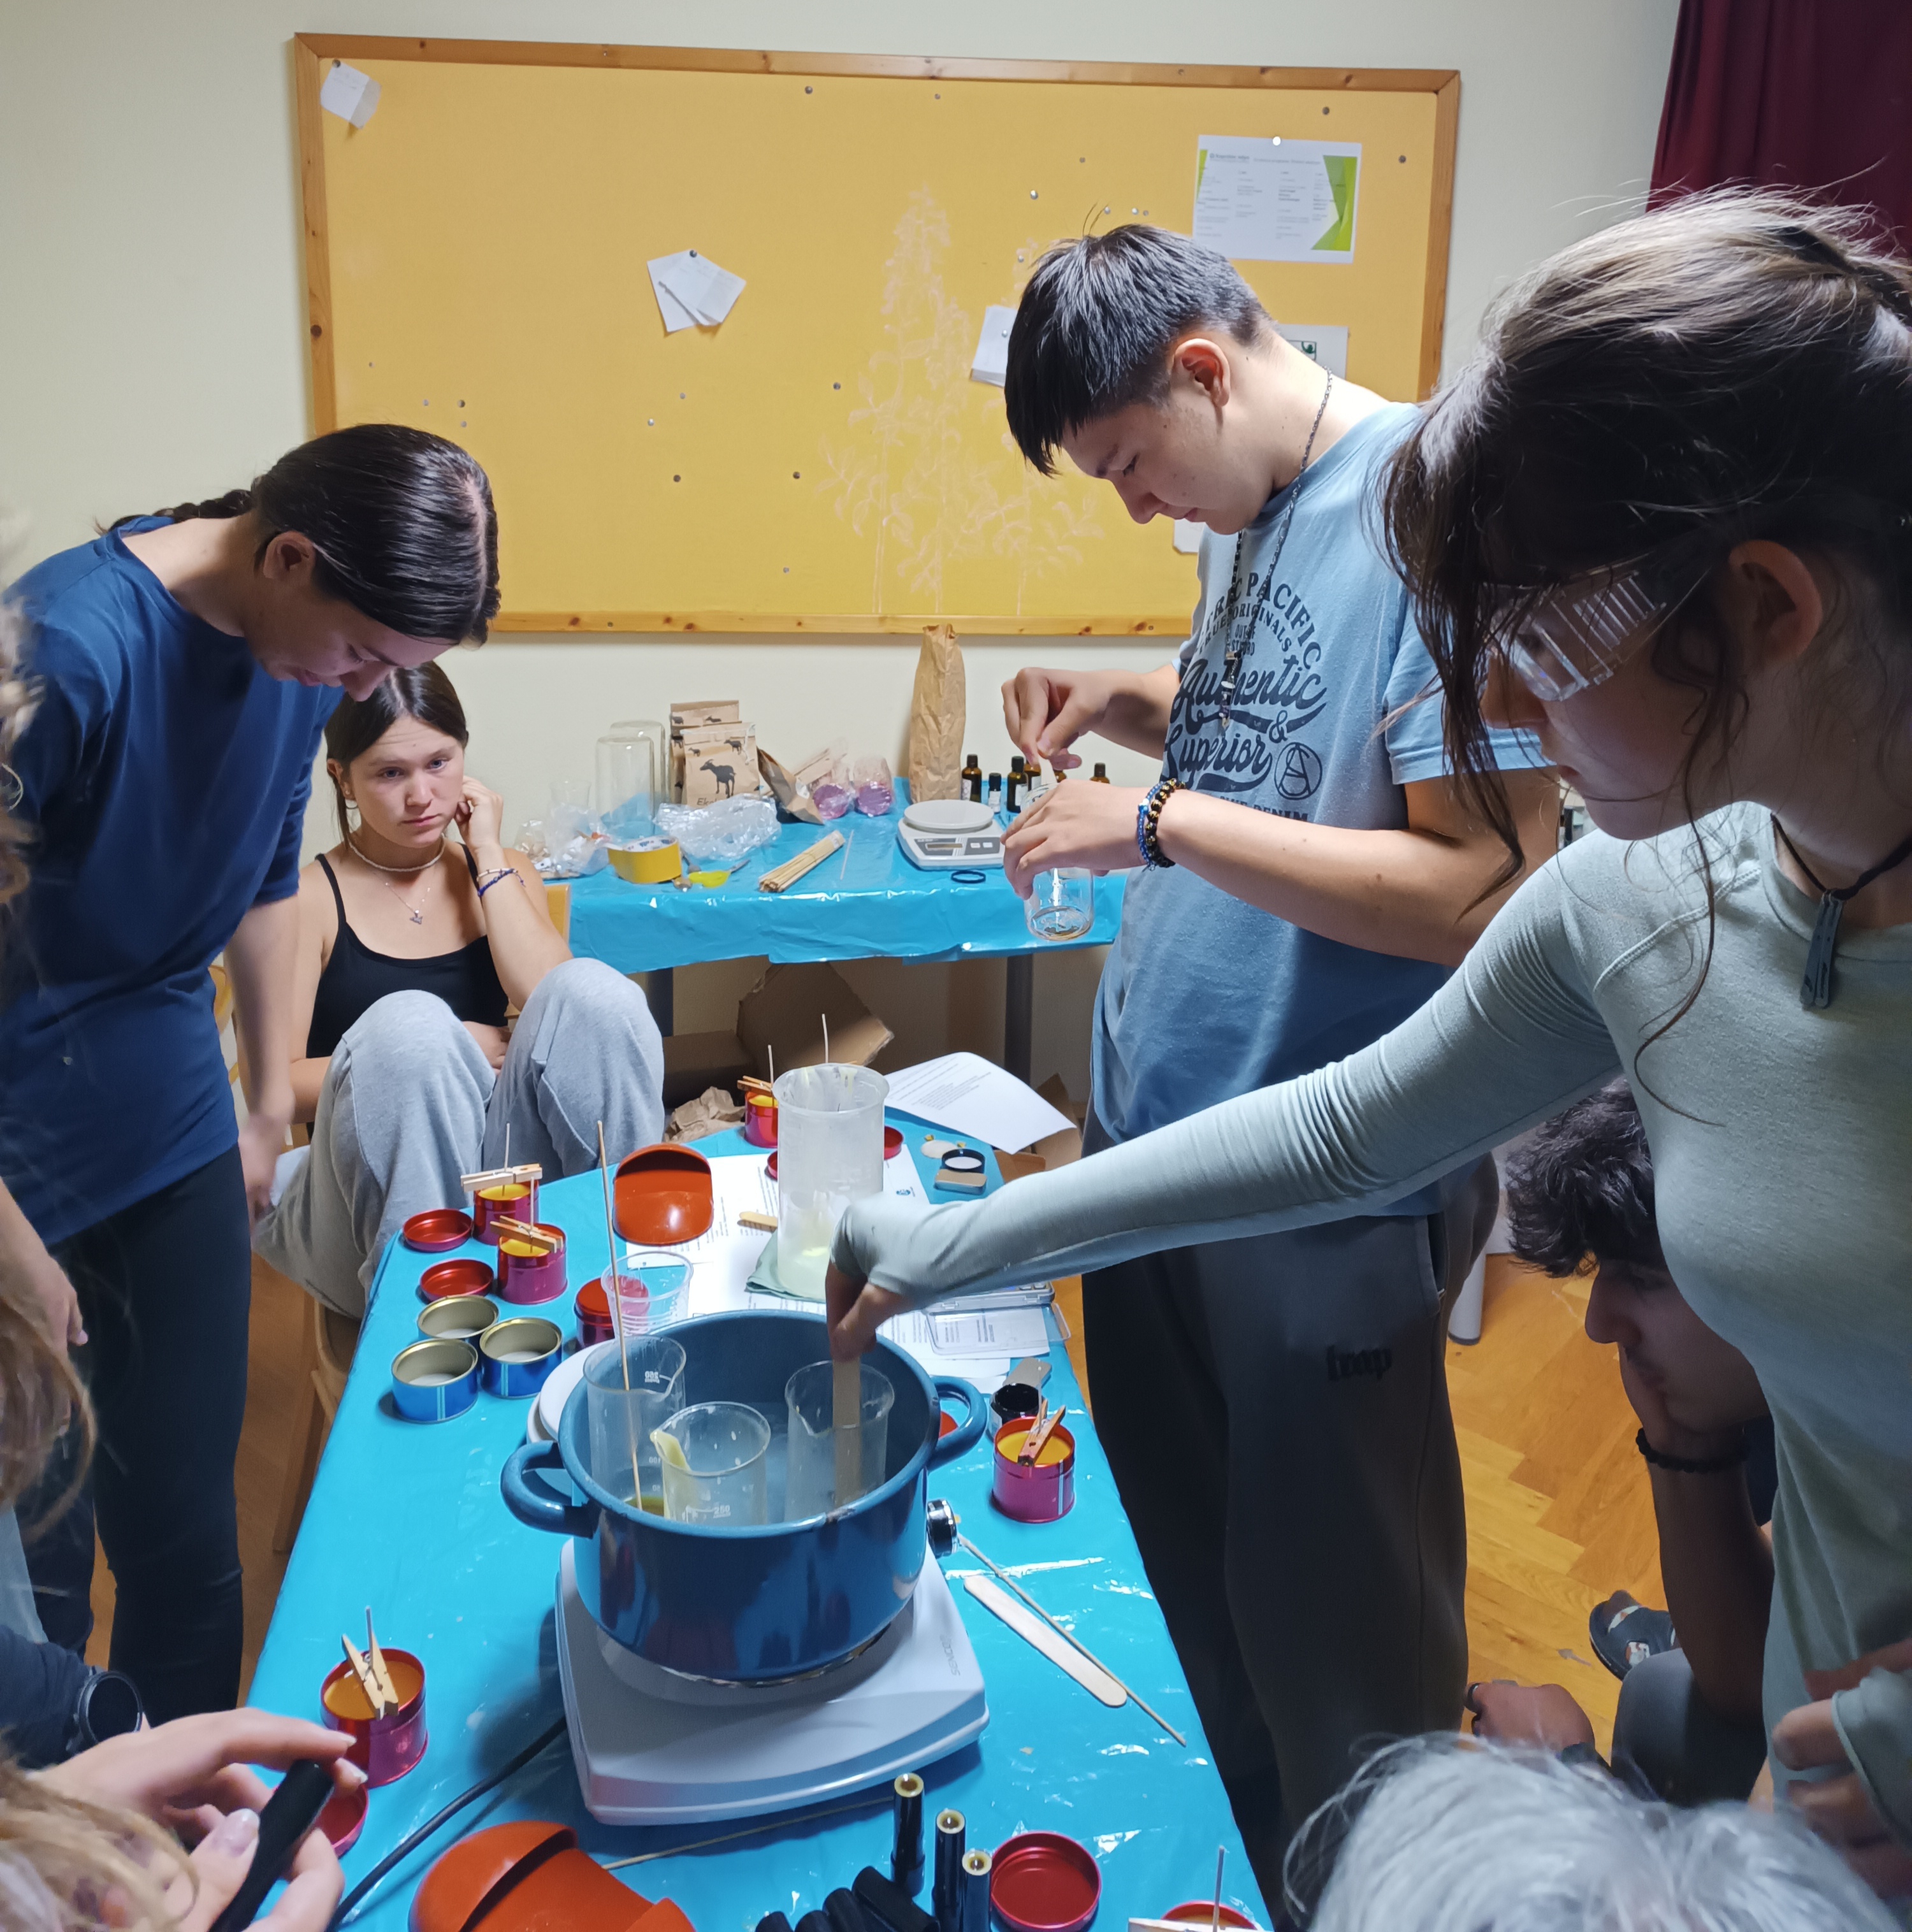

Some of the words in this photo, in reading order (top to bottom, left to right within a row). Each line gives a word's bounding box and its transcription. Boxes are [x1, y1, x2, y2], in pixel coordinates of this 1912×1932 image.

[1233, 603, 1293, 652] ORIGINALS
[1246, 572, 1322, 670] PACIFIC
[1170, 654, 1328, 735] Authentic
[1269, 710, 1288, 743] &
[1160, 724, 1273, 791] Superior
[939, 1634, 961, 1676] SENCOR
